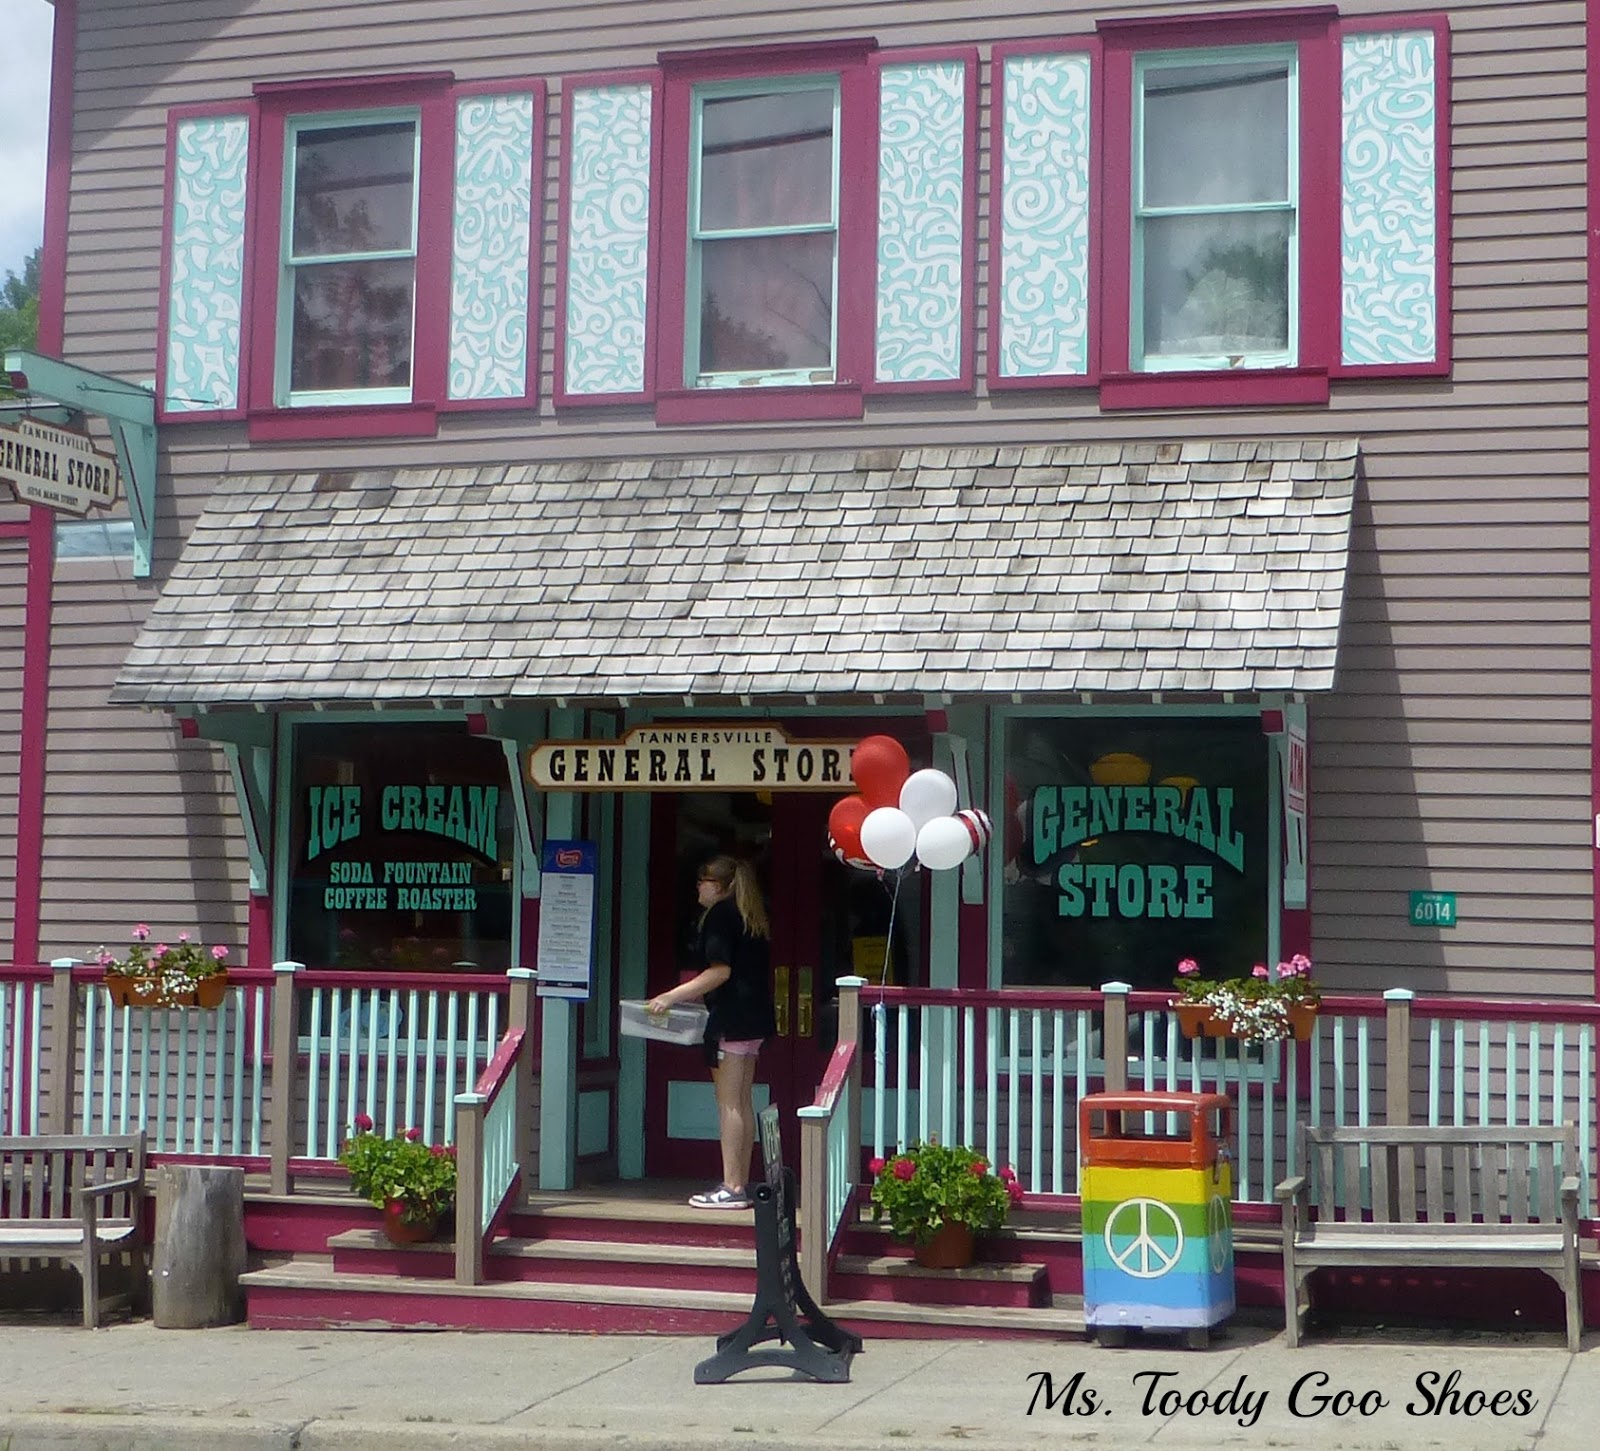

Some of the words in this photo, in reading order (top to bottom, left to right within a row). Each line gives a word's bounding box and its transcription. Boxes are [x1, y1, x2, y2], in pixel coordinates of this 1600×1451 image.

[23, 424, 89, 453] TANNERSVILLE
[67, 458, 110, 495] STORE
[639, 731, 772, 744] TANNERSVILLE
[549, 748, 716, 782] GENERAL
[752, 748, 856, 782] STOR
[308, 785, 361, 861] ICE
[381, 785, 499, 862] CREAM
[1032, 785, 1244, 874] GENERAL
[330, 862, 374, 884] SODA
[383, 862, 472, 884] FOUNTAIN
[324, 888, 388, 910] COFFEE
[397, 888, 477, 911] ROASTER
[1057, 863, 1213, 918] STORE
[1415, 902, 1451, 920] 6014
